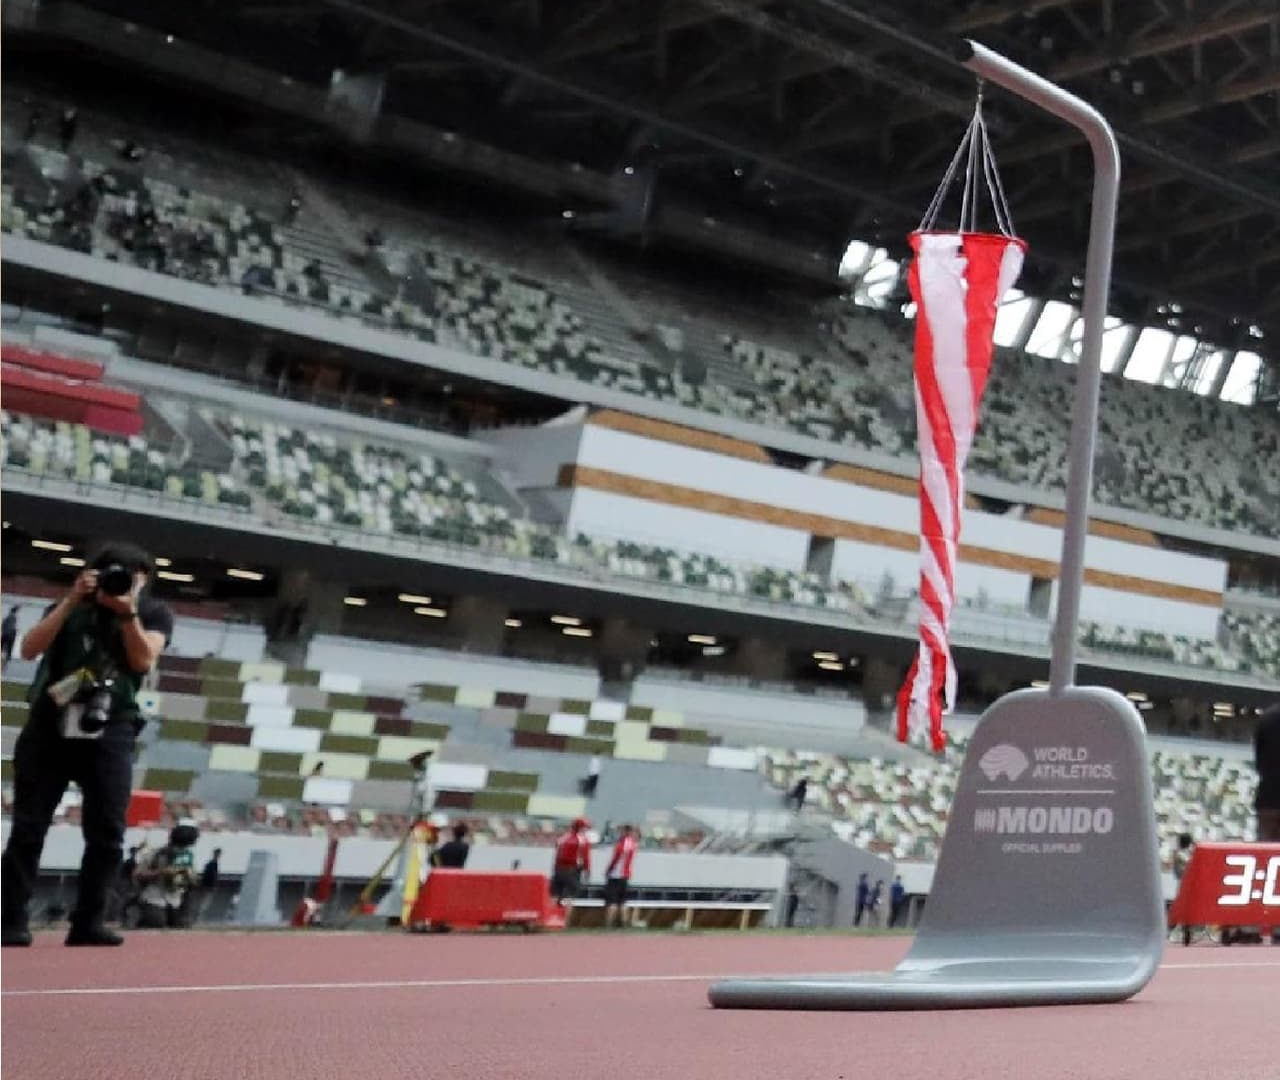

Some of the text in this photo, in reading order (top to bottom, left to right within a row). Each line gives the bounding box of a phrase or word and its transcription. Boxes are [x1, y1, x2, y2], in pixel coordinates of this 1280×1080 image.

[1034, 747, 1087, 761] WORLD
[1032, 764, 1112, 778] ATHLETICS
[997, 807, 1113, 834] MONDO
